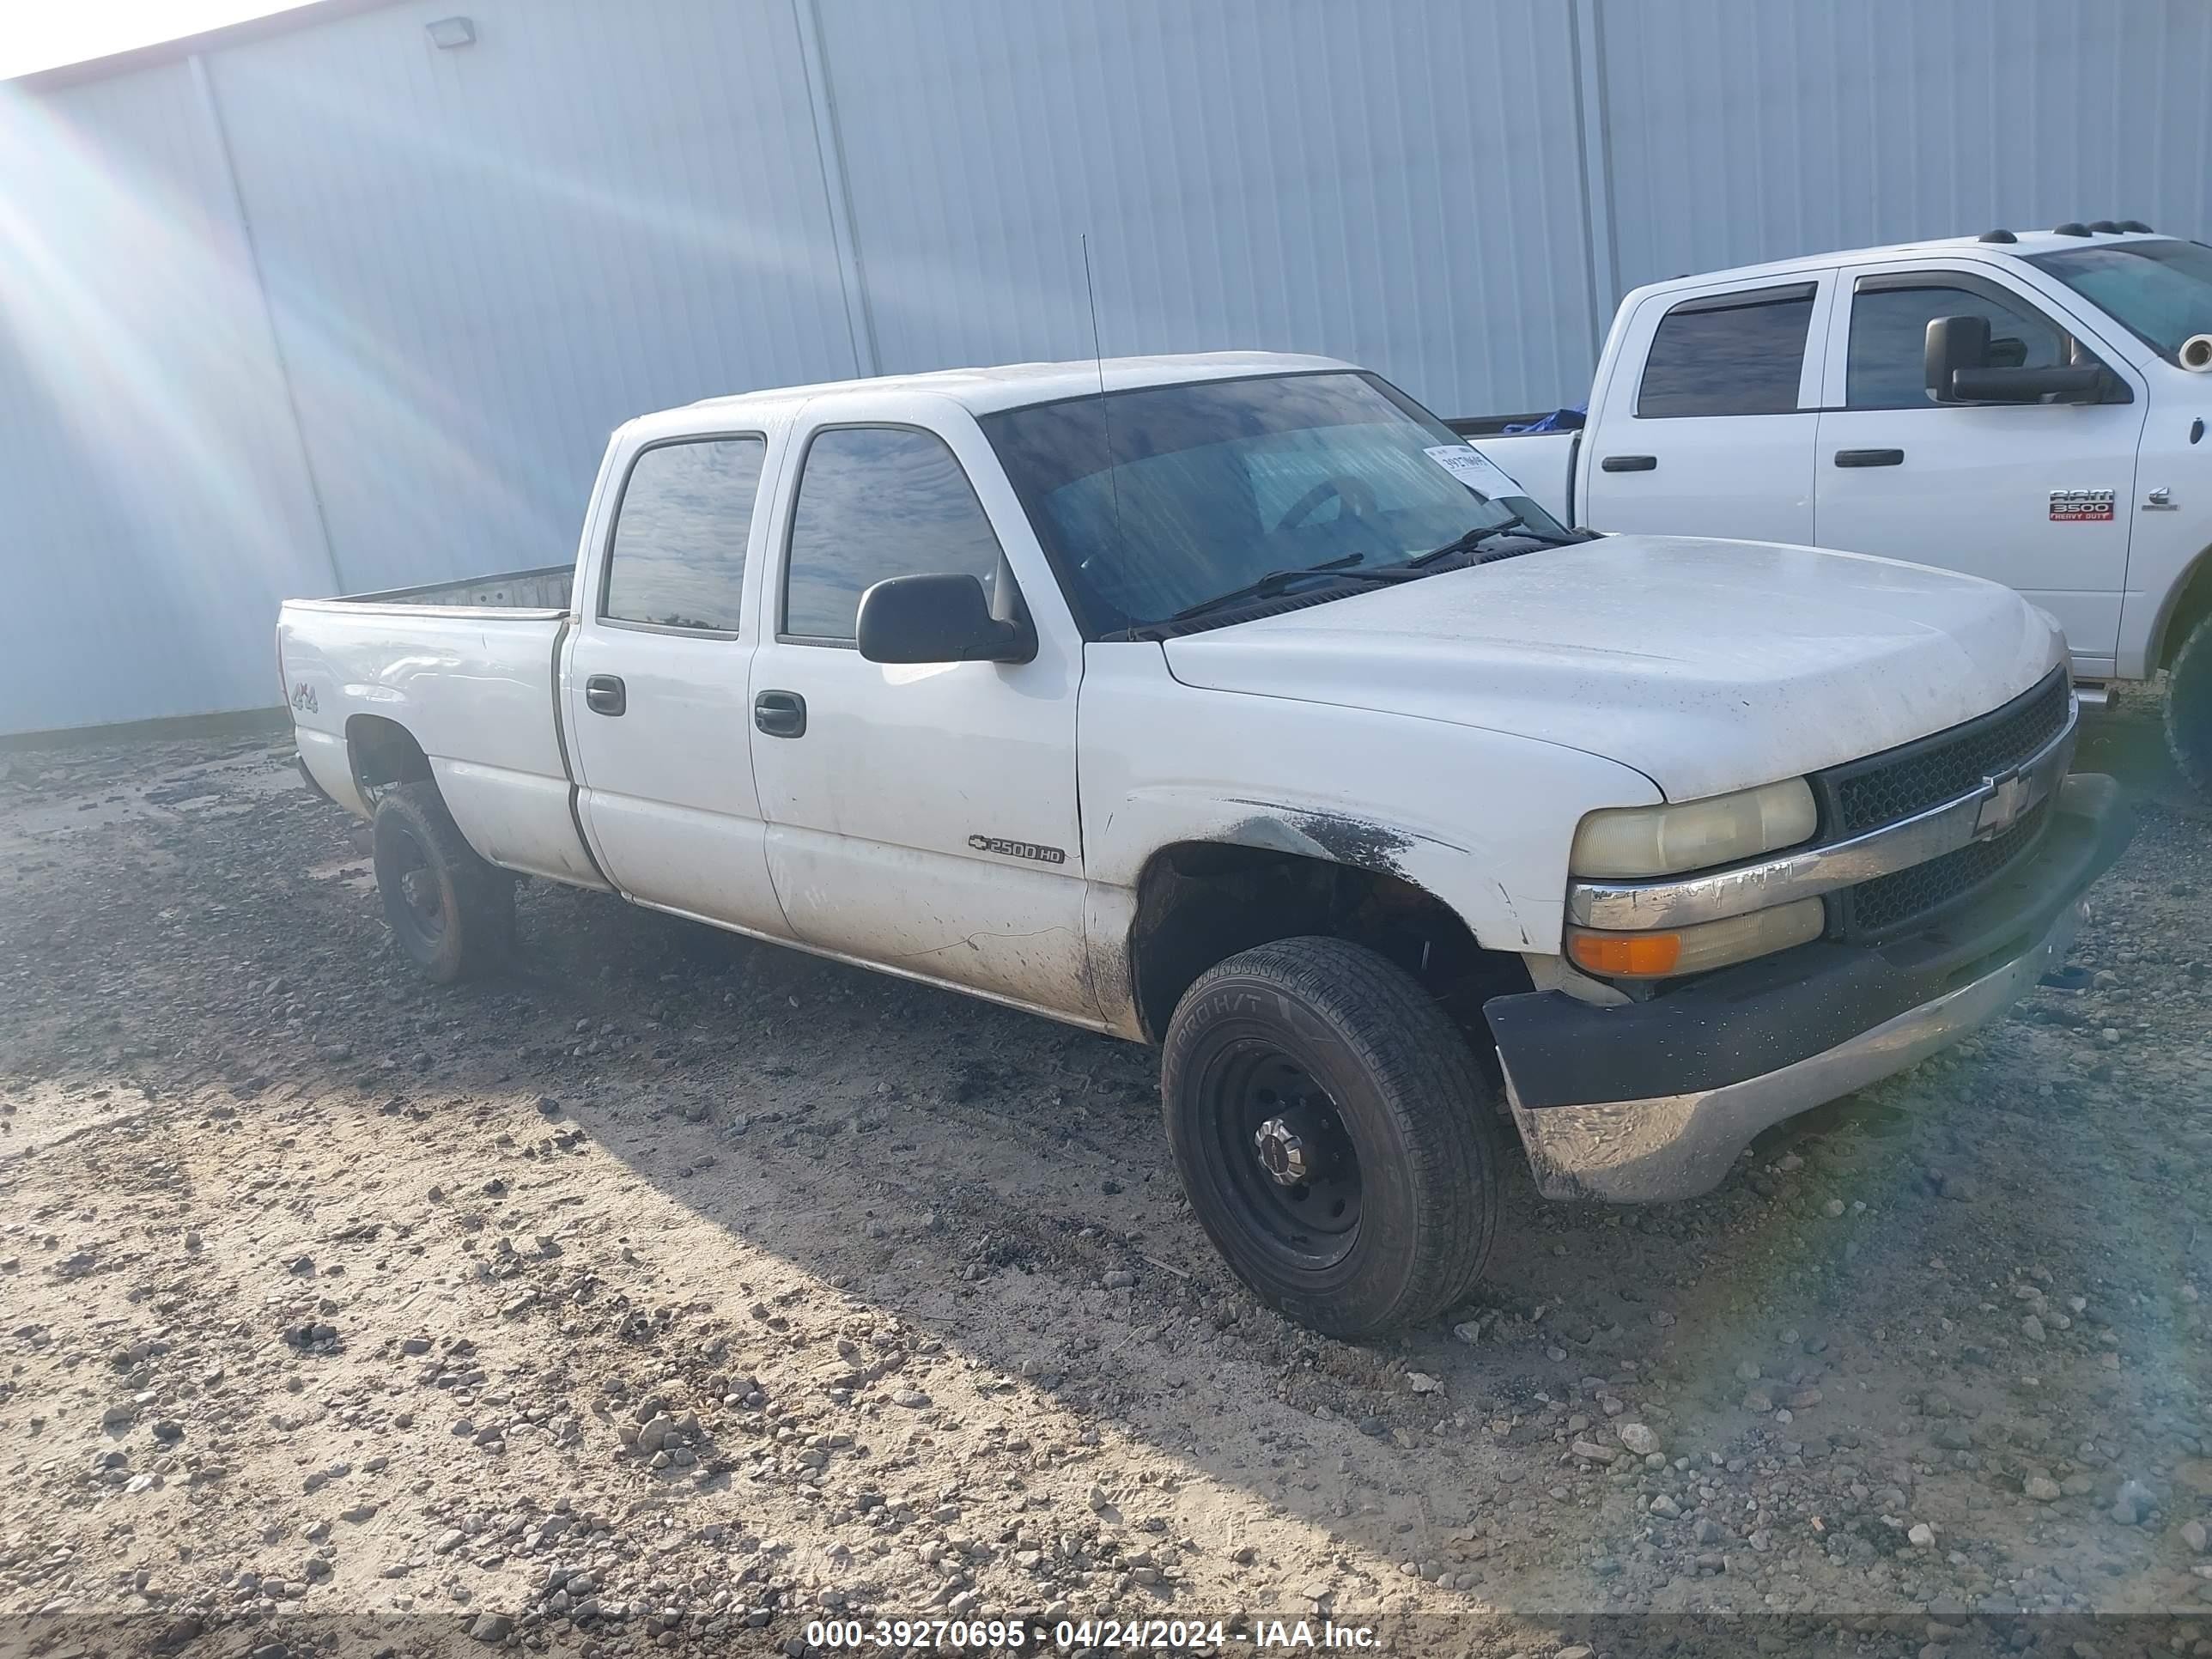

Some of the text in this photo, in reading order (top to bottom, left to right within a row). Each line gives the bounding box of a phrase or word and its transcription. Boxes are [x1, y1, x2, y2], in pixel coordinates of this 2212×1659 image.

[2050, 489, 2114, 502] RAM
[2053, 503, 2109, 513] 3500
[990, 840, 1060, 862] 2500 HD
[1213, 993, 1261, 1014] H/T
